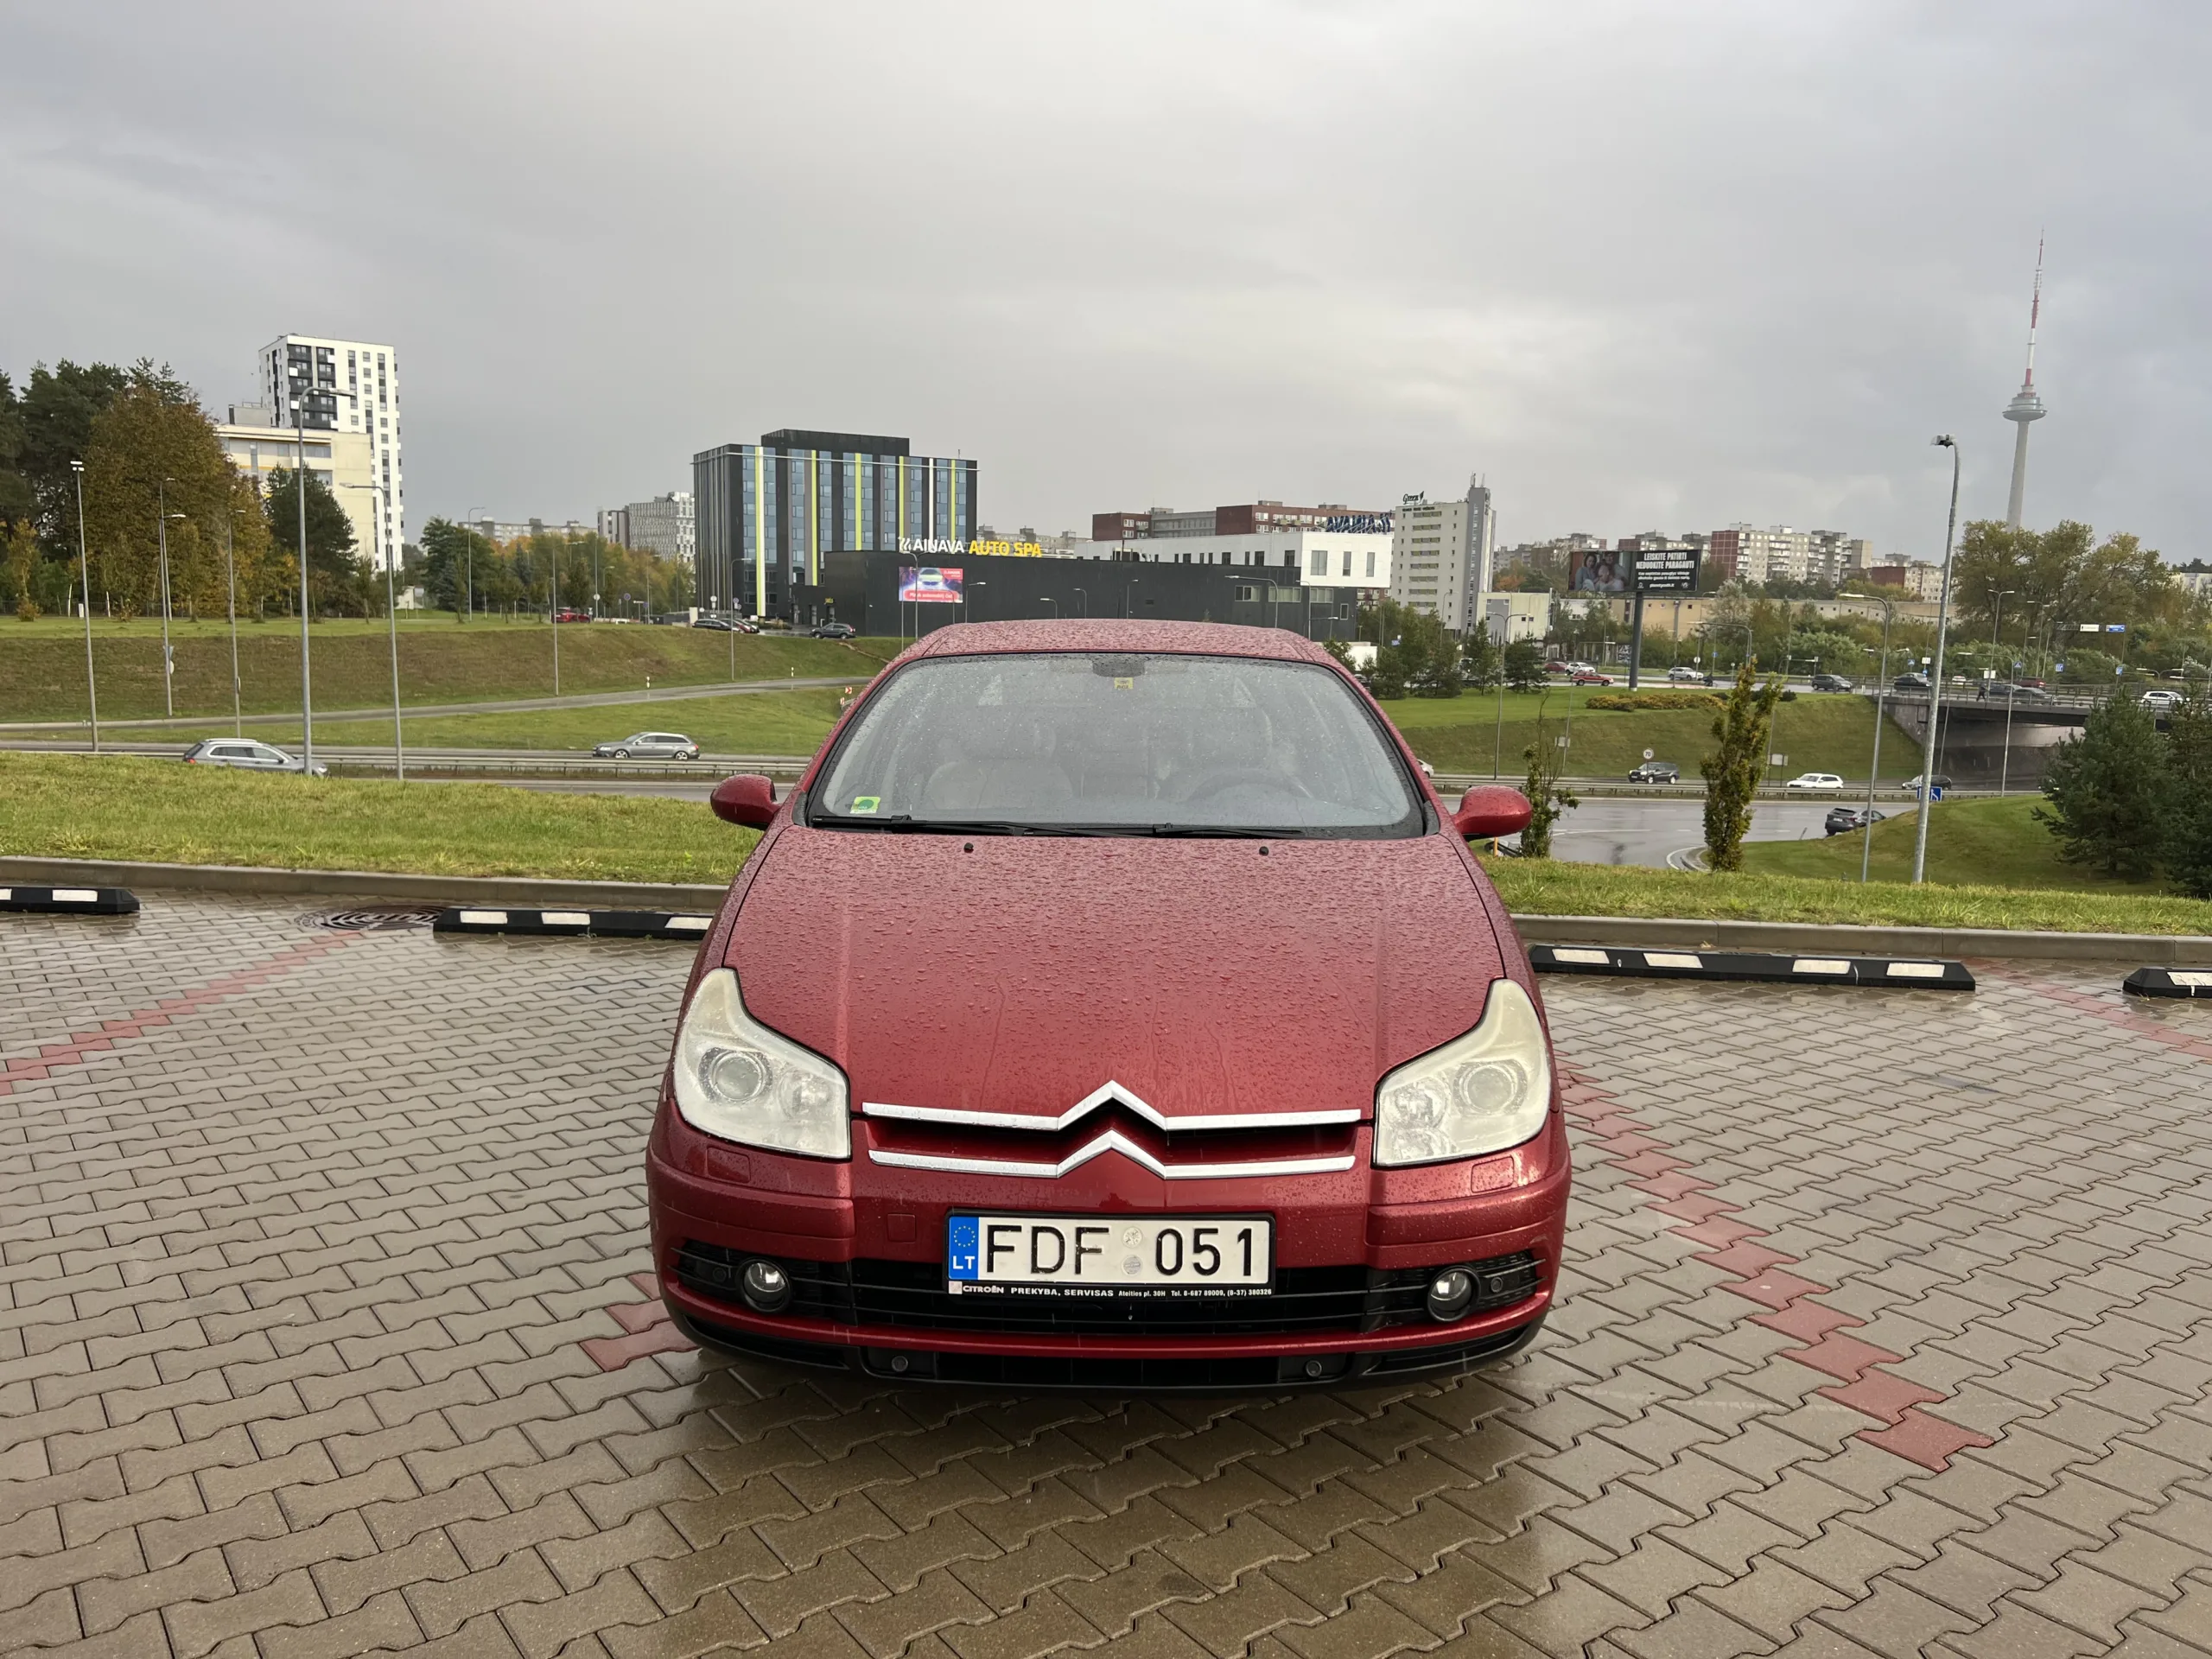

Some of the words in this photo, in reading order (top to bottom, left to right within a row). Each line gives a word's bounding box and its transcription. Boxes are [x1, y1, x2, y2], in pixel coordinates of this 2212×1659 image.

[969, 540, 1010, 556] AUTO
[1014, 542, 1042, 557] SPA
[986, 1224, 1109, 1274] FDF
[1155, 1228, 1252, 1276] 051
[953, 1255, 975, 1269] LT
[963, 1285, 1004, 1294] CITROËN
[1011, 1287, 1061, 1296] PREKYBA,
[1064, 1288, 1114, 1297] SERVISAS
